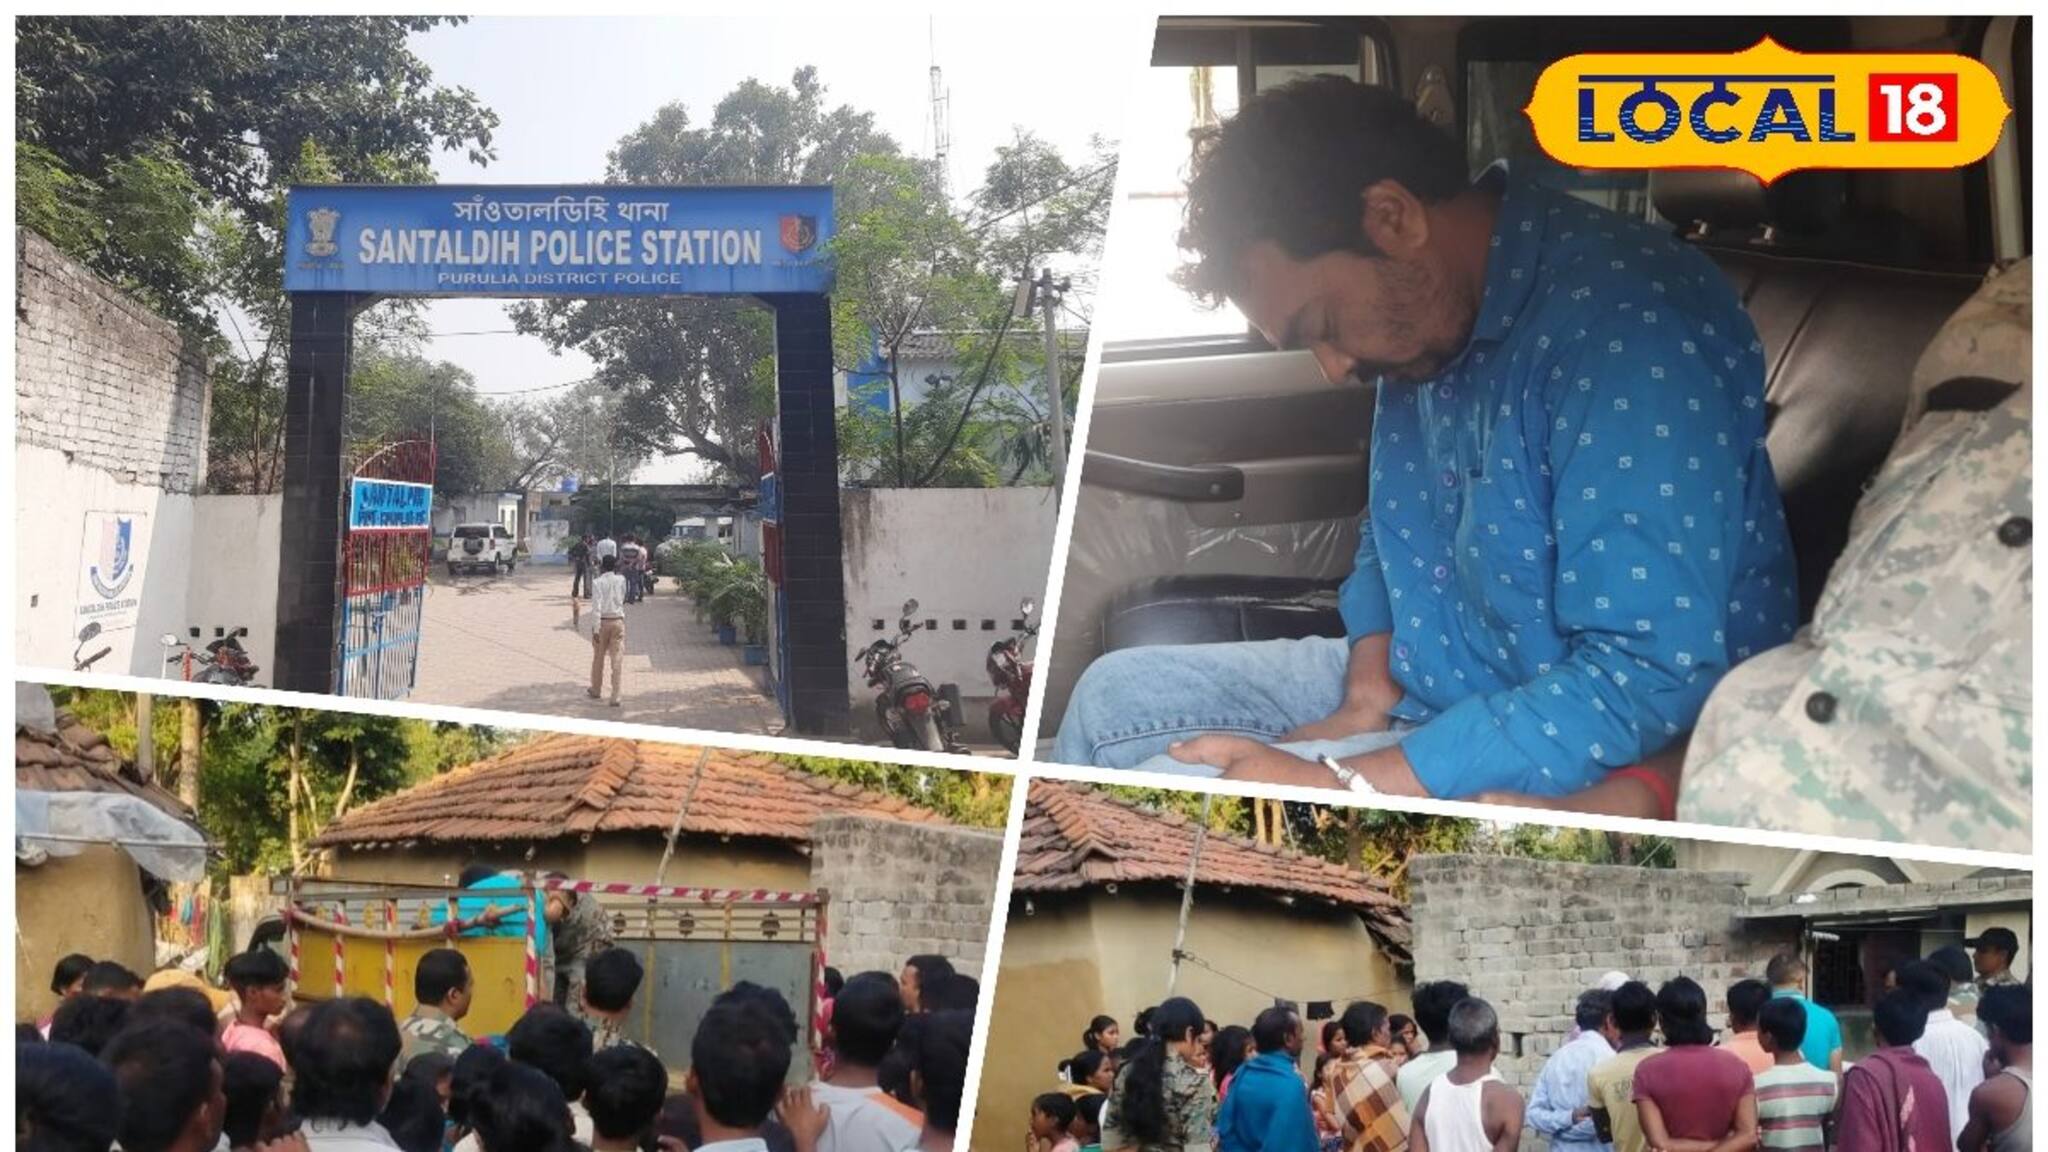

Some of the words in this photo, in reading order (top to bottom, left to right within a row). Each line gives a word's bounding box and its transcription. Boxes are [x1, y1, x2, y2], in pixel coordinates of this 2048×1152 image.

[453, 194, 610, 223] সাঁওতালডিহি
[617, 202, 670, 223] থানা
[359, 228, 520, 265] SANTALDIH
[530, 229, 632, 265] POLICE
[641, 229, 761, 265] STATION
[437, 272, 519, 285] PURULIA
[525, 272, 609, 285] DISTRICT
[614, 272, 682, 285] POLICE
